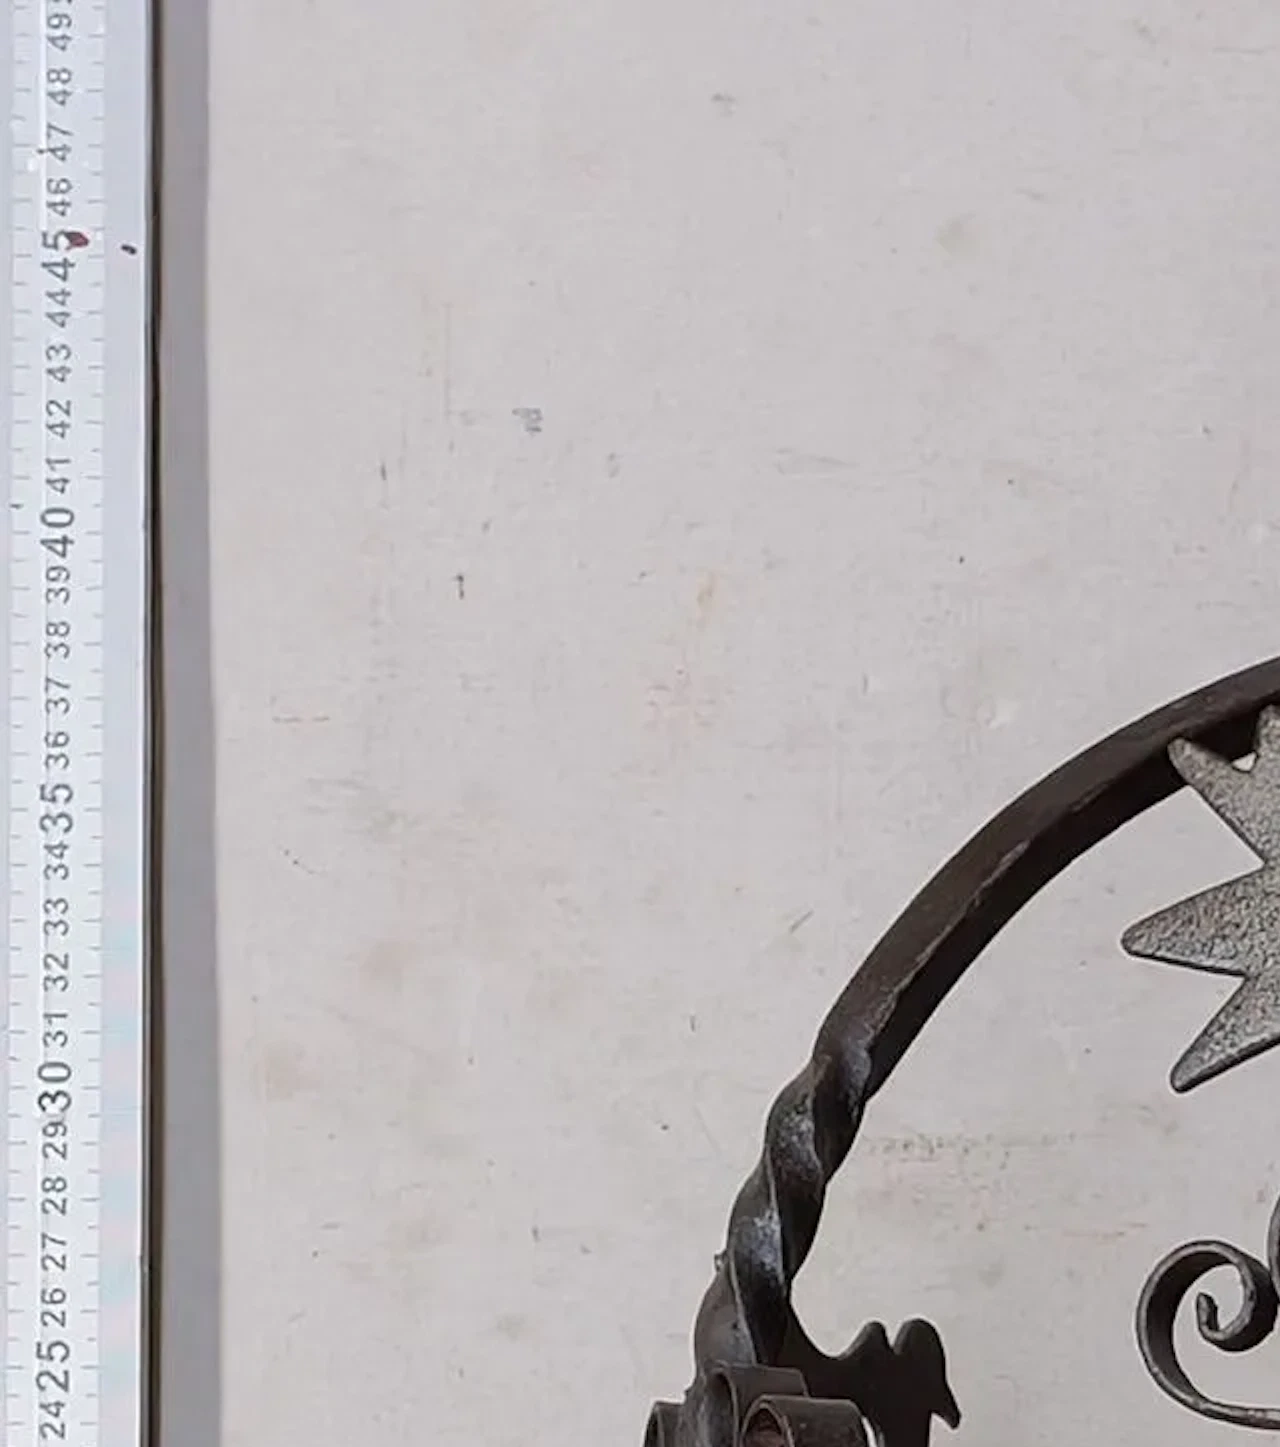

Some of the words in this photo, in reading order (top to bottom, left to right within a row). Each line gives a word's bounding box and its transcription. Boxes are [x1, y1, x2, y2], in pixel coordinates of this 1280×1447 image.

[46, 13, 72, 51] 49
[46, 68, 72, 106] 48
[43, 123, 72, 162] 47
[46, 178, 72, 217] 46
[41, 230, 77, 282] 45
[45, 288, 71, 328] 44
[45, 344, 72, 383] 43
[46, 400, 71, 439] 42
[45, 458, 71, 494] 41
[40, 507, 74, 558] 40
[45, 565, 70, 604] 39
[44, 621, 70, 660] 38
[44, 675, 70, 715] 37
[44, 731, 70, 770] 36
[39, 783, 73, 834] 35
[43, 841, 69, 880] 34
[43, 898, 69, 939] 33
[43, 953, 69, 992] 32
[42, 1012, 68, 1048] 31
[37, 1062, 71, 1112] 30
[42, 1119, 67, 1160] 29
[41, 1176, 67, 1215] 28
[41, 1232, 66, 1271] 27
[40, 1288, 66, 1327] 26
[35, 1340, 70, 1393] 25
[39, 1401, 65, 1439] 24
